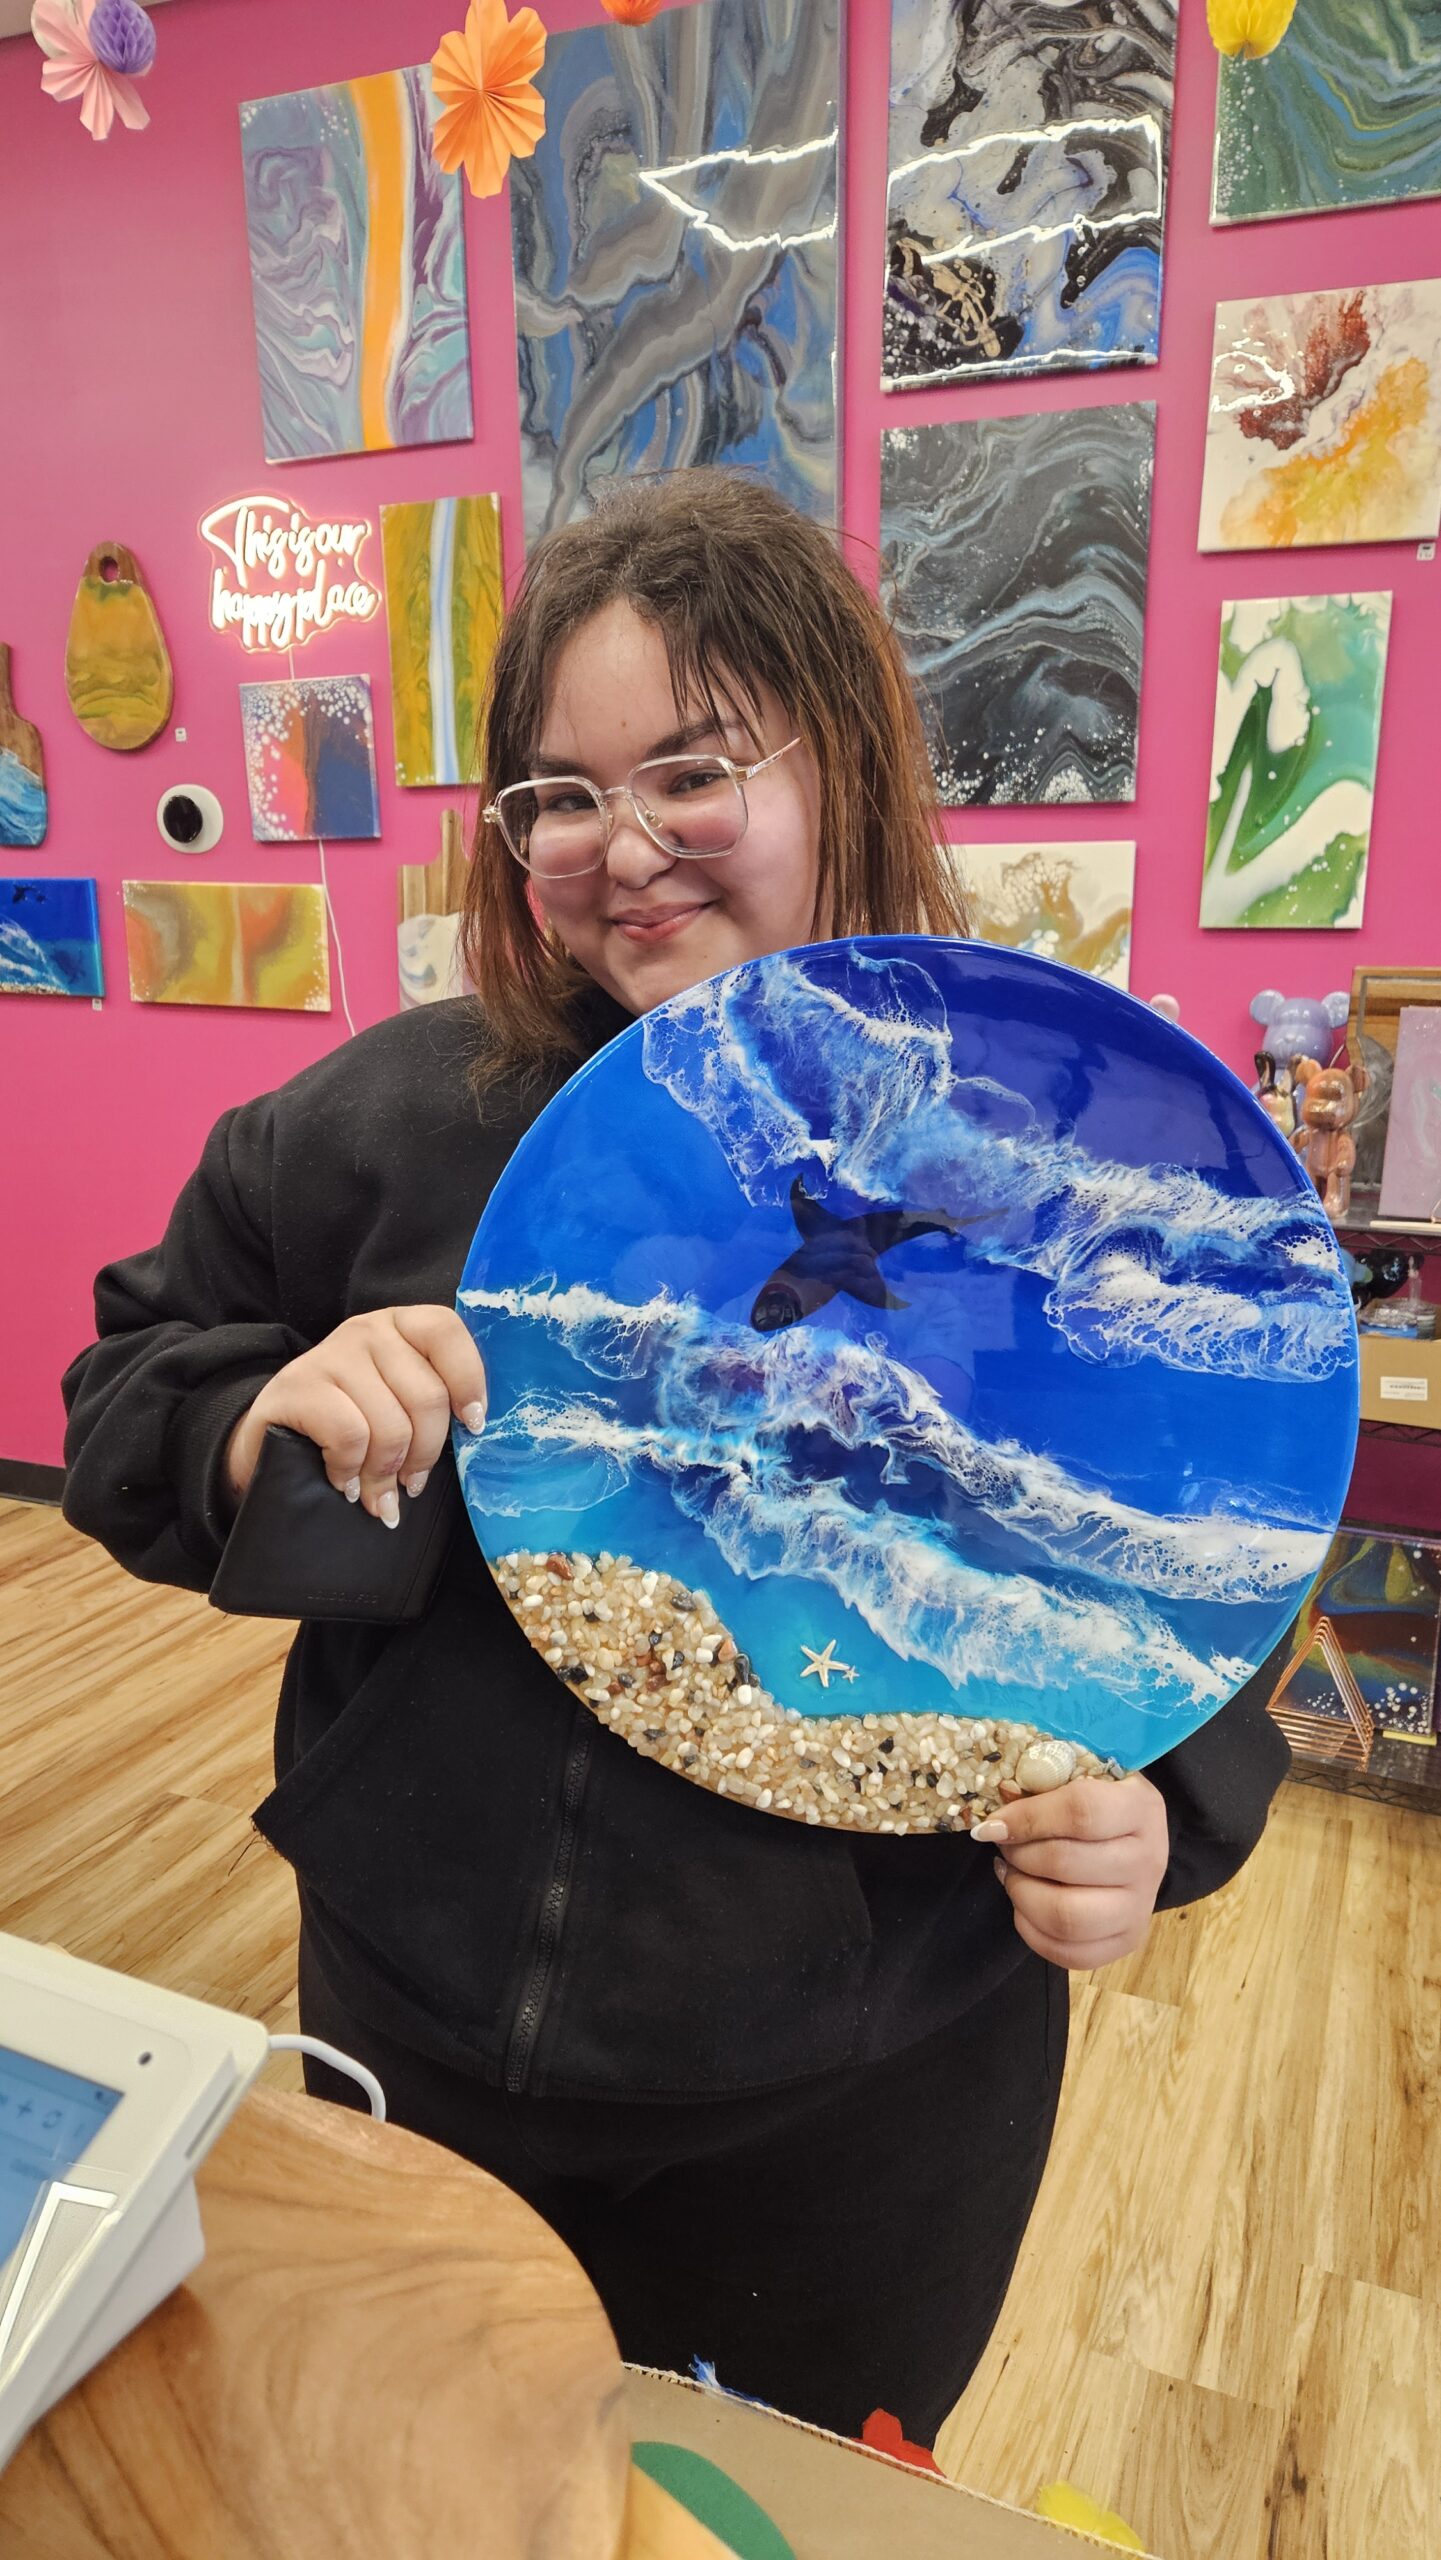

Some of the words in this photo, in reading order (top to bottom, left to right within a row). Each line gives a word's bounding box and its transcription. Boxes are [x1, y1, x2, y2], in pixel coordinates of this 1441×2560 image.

[201, 496, 288, 588] This
[288, 512, 316, 576] is
[315, 523, 366, 556] our
[212, 567, 295, 648] happy
[295, 558, 376, 641] place
